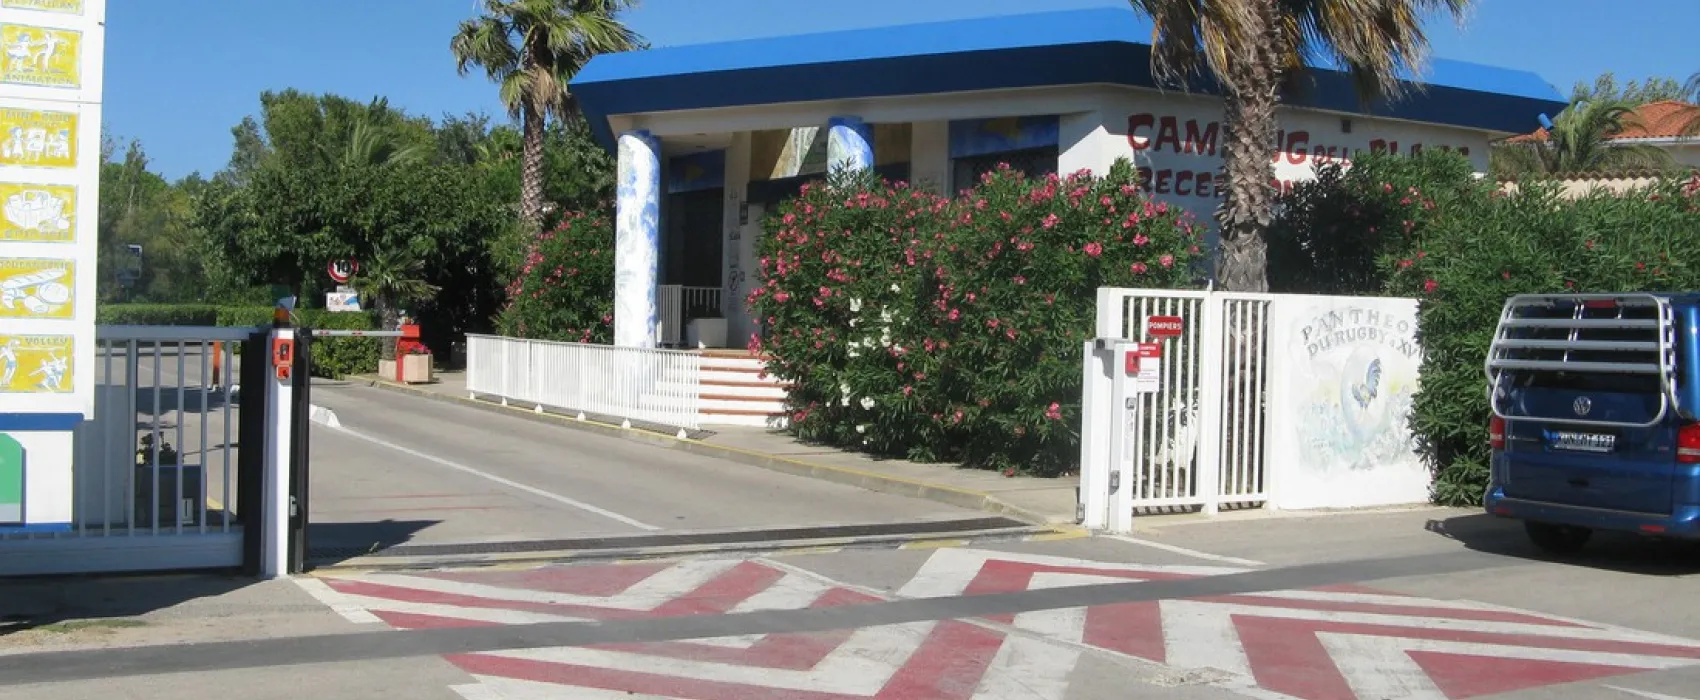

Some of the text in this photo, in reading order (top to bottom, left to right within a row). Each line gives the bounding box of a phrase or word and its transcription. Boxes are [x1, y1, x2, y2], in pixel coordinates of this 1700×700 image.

[3, 73, 74, 85] ANIMATION
[1127, 112, 1310, 166] CAMG
[1149, 321, 1182, 331] POMPIERS
[25, 336, 68, 346] VOLLEY
[1334, 326, 1389, 346] RUGBY
